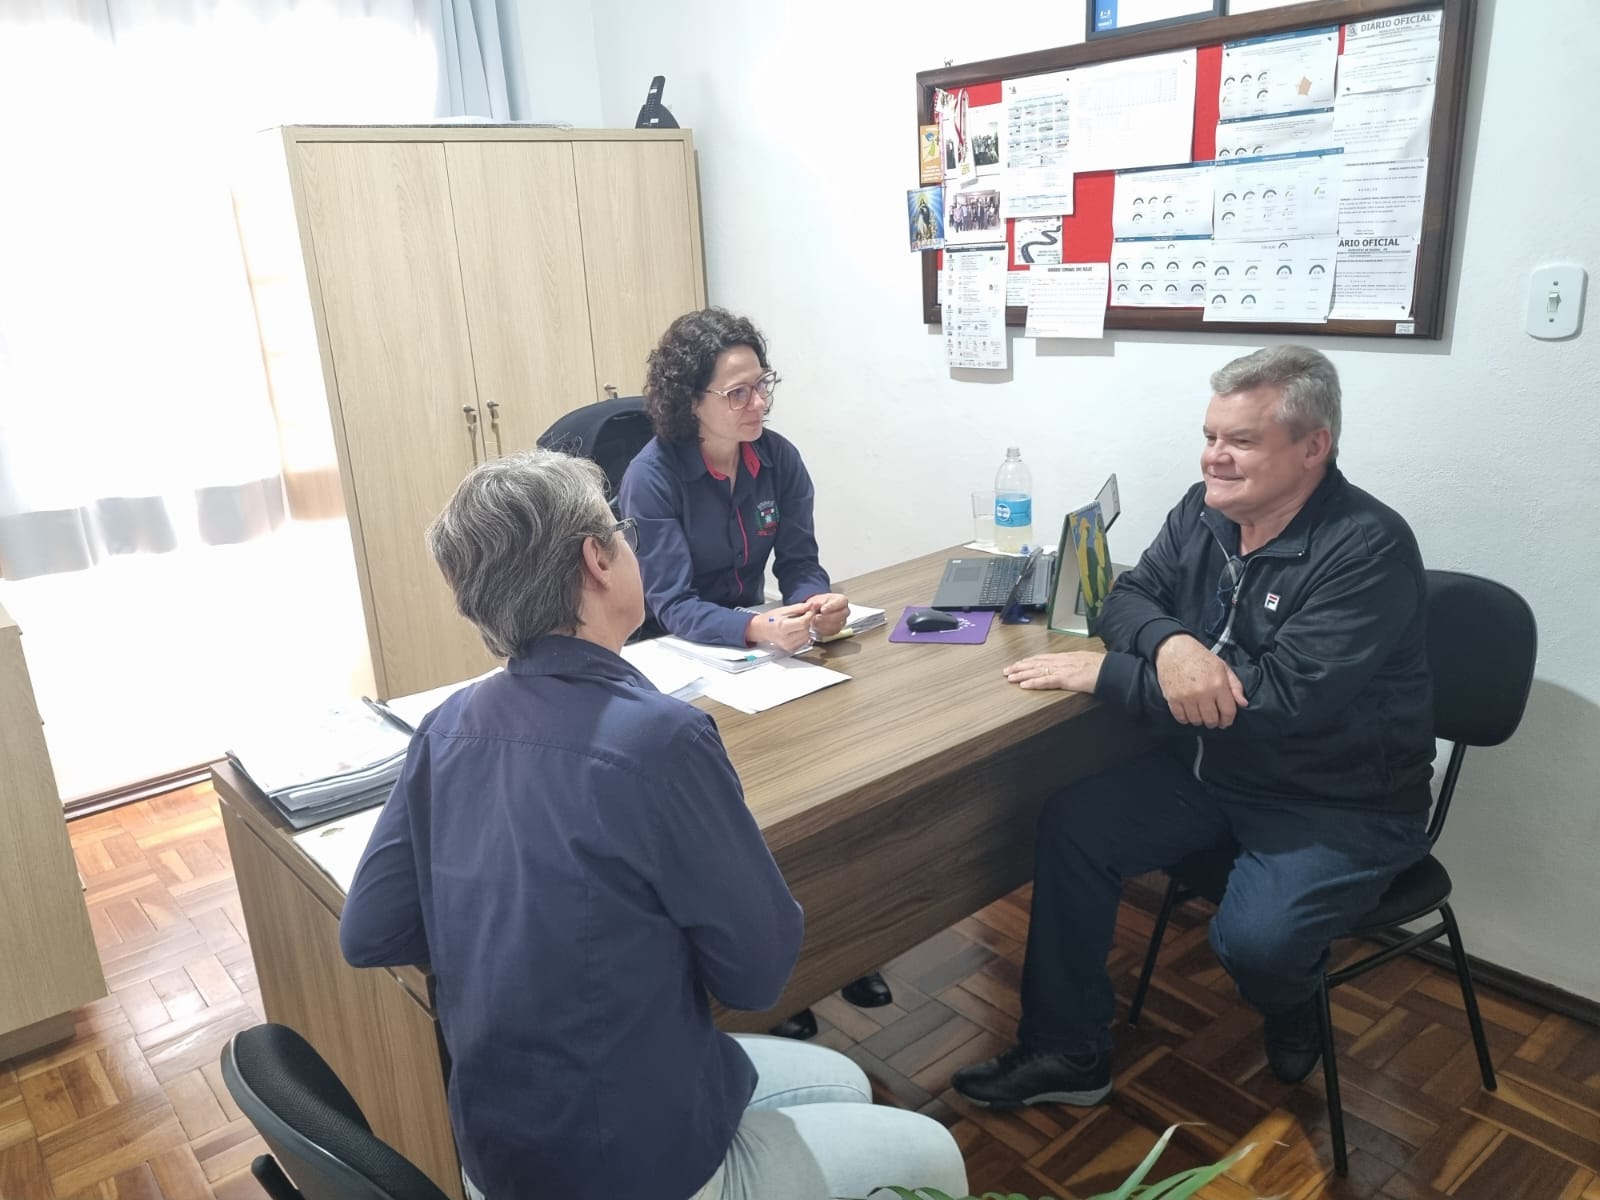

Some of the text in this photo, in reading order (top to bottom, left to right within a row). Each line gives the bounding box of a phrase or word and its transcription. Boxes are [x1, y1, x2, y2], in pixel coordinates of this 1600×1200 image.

[1361, 19, 1391, 32] DIÁRIO
[1394, 14, 1432, 26] OFICIAL
[1338, 237, 1400, 247] ÁRIO OFICIAL
